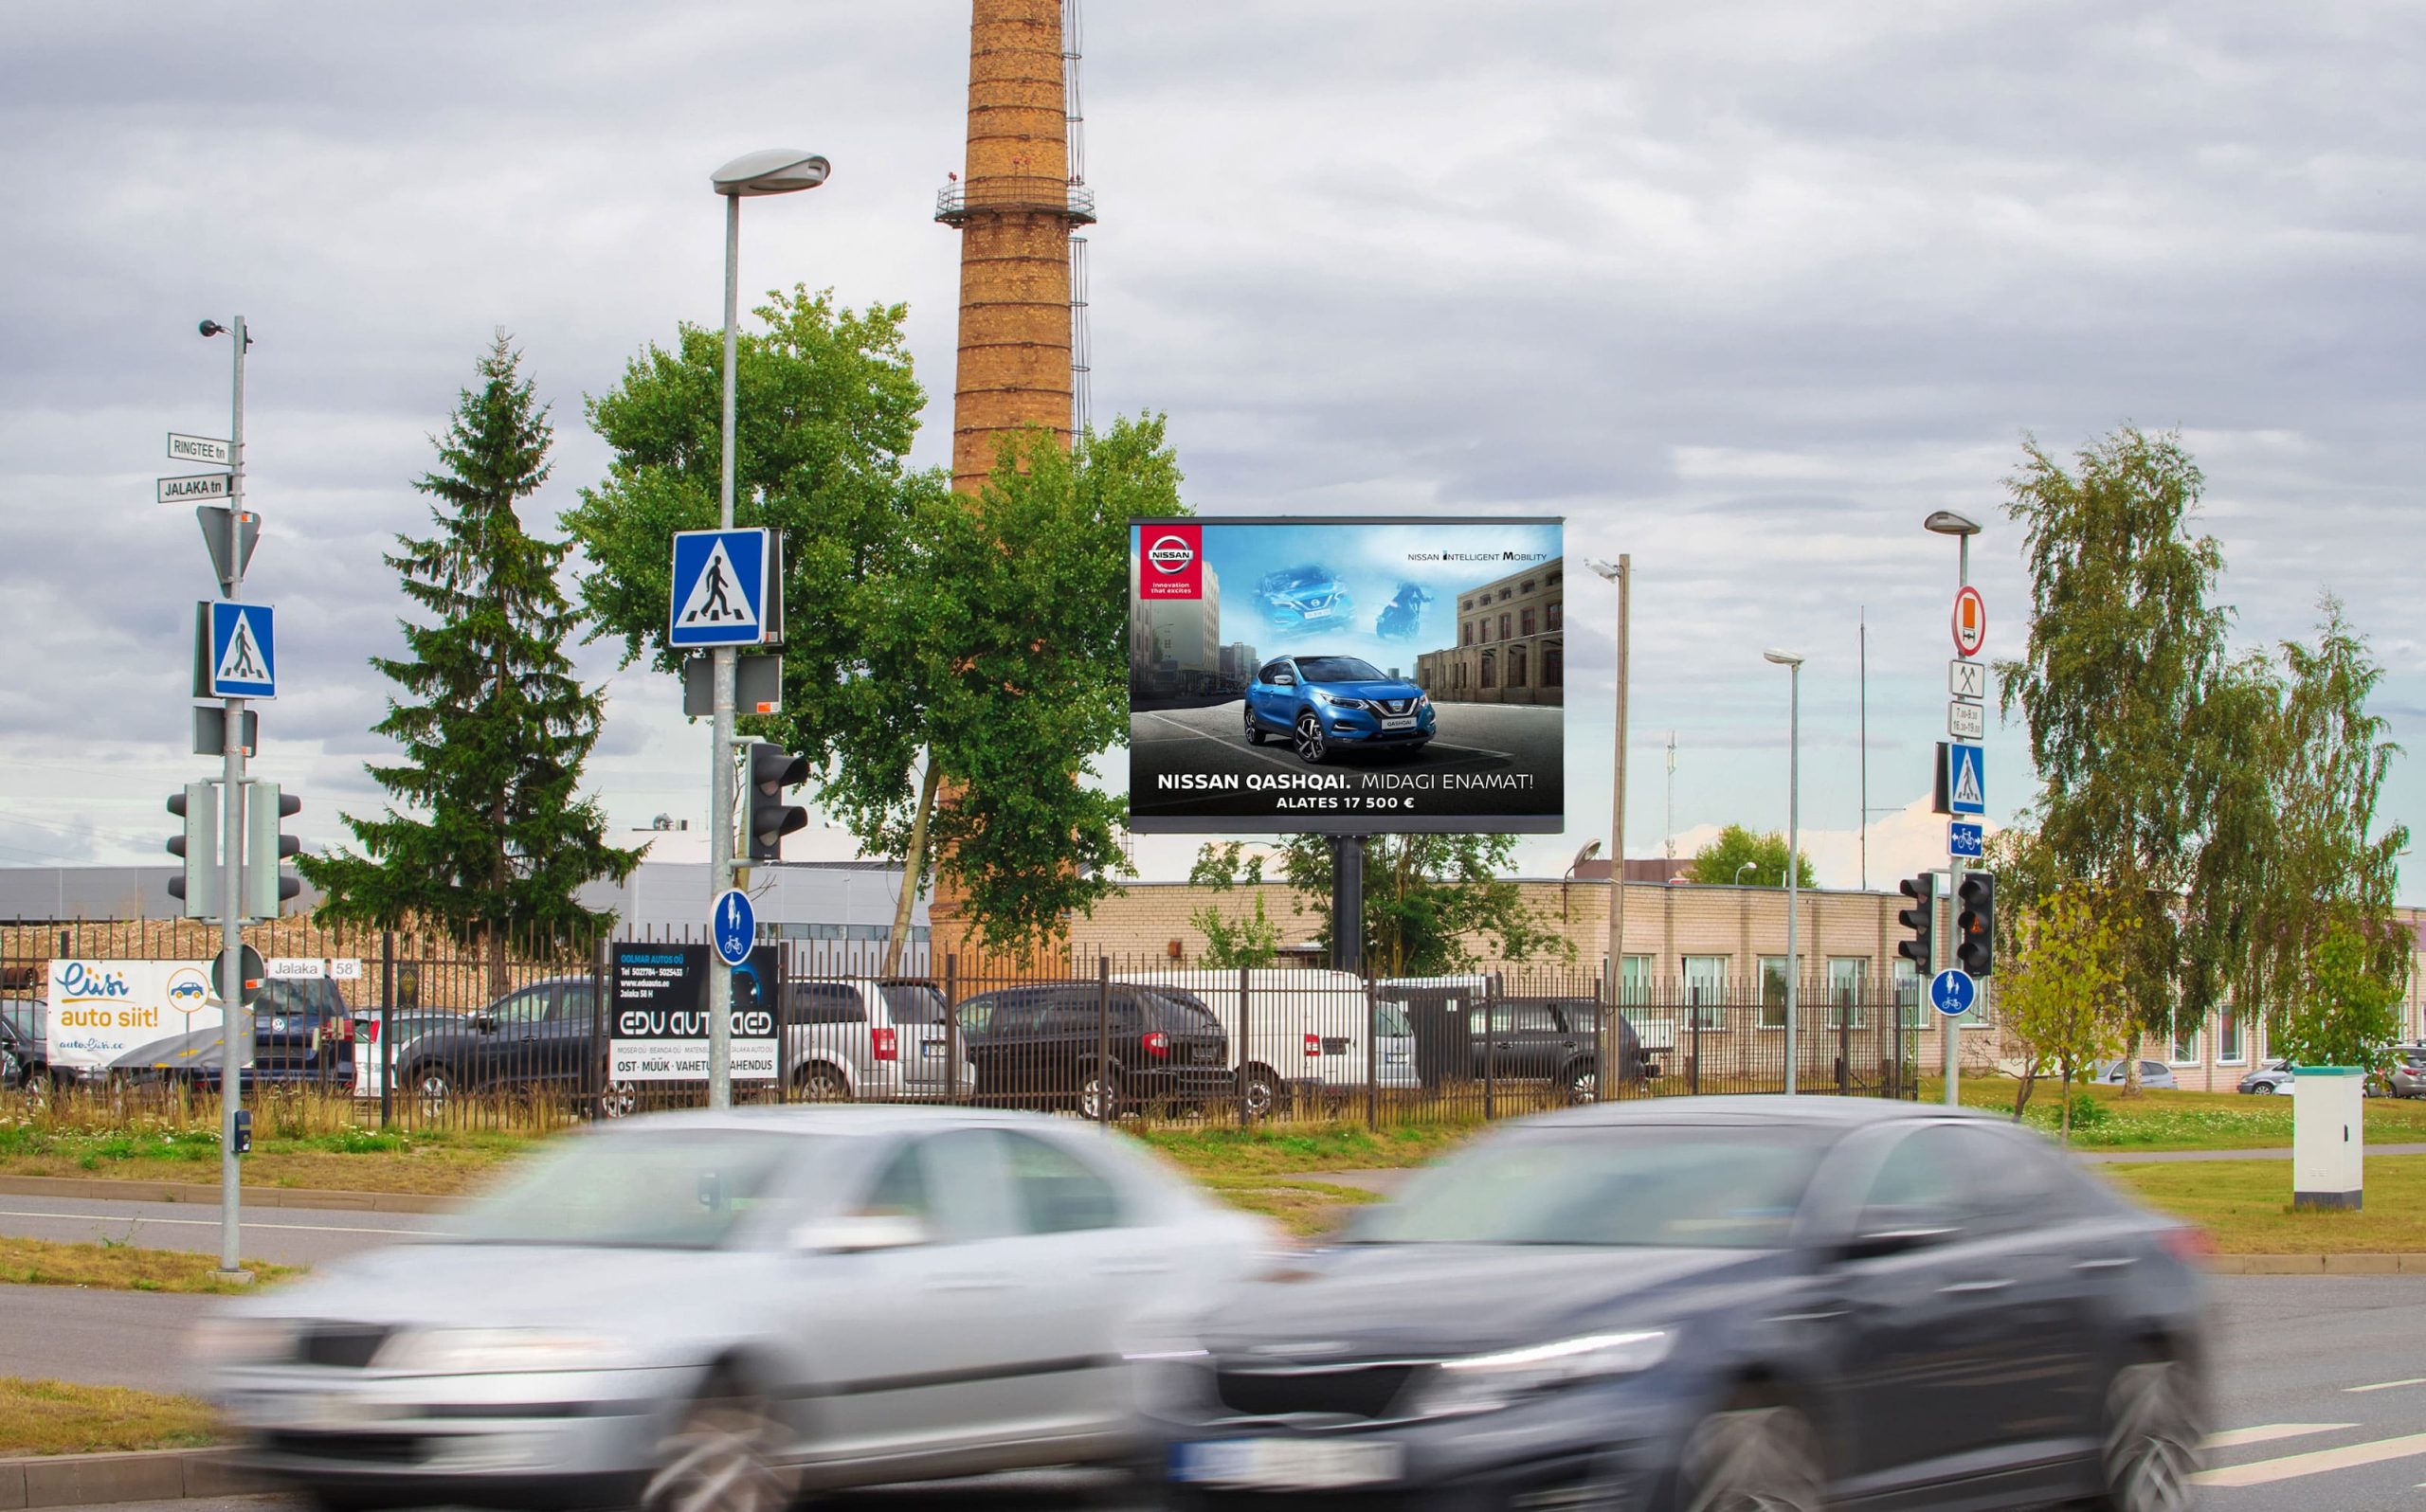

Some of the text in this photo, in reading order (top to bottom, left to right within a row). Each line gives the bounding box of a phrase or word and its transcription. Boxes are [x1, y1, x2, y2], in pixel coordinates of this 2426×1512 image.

[174, 440, 226, 459] RINGTEE tn
[165, 480, 222, 496] JALAKA tn
[1158, 774, 1533, 791] NISSAN QASHQAI. MIDAGI ENAMAT!
[1276, 797, 1415, 808] ALATES 17 500 €
[275, 963, 317, 975] Jalaka
[61, 1007, 158, 1027] auto siit!
[620, 1011, 666, 1035] EDU
[642, 1057, 671, 1071] MÜÜK
